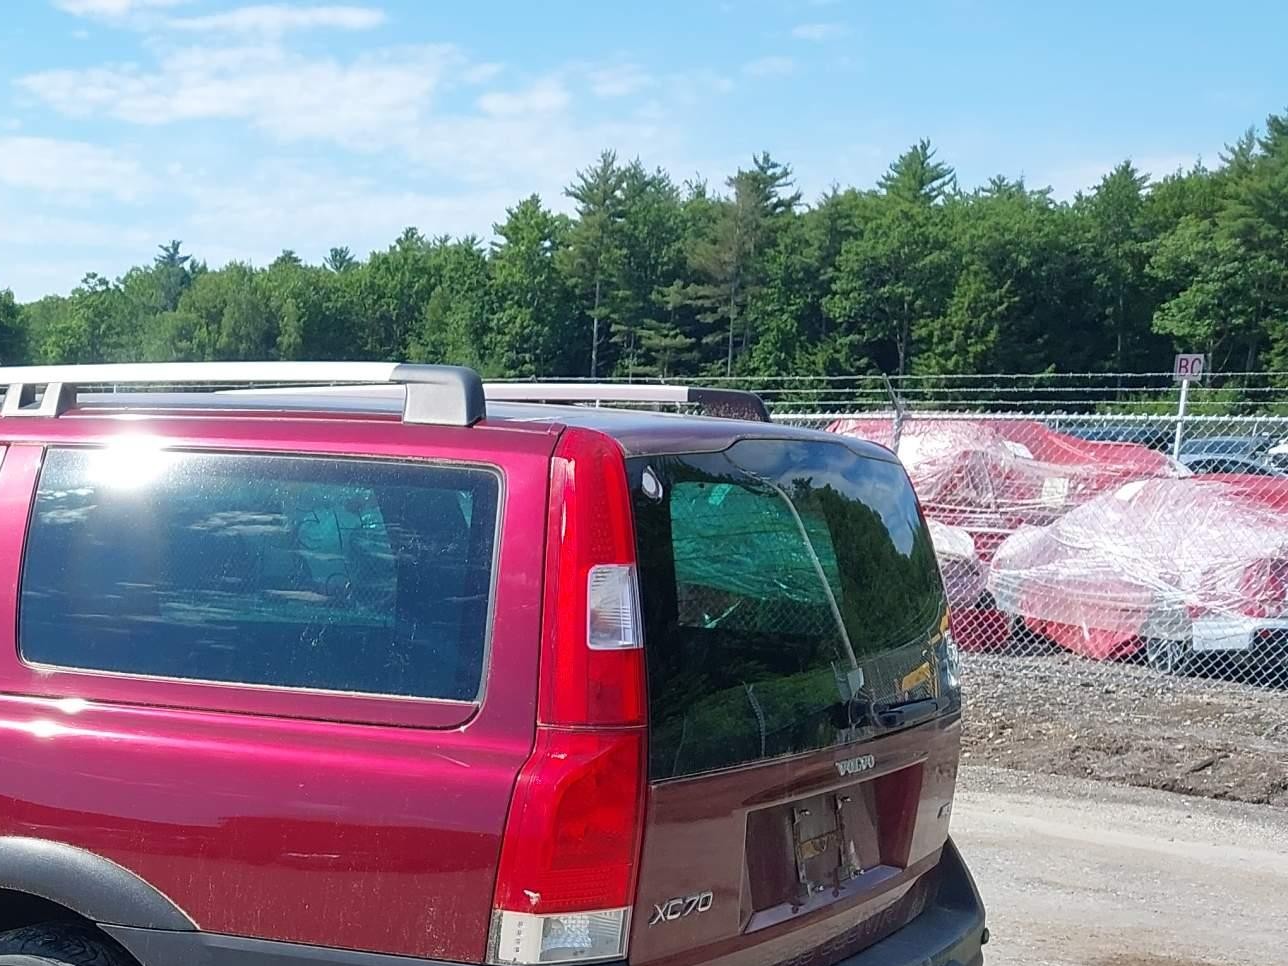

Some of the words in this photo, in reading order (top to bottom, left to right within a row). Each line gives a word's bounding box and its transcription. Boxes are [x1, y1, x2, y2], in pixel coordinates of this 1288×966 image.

[1178, 357, 1202, 377] BC
[834, 754, 875, 776] VOLVO
[648, 891, 714, 928] XC70
